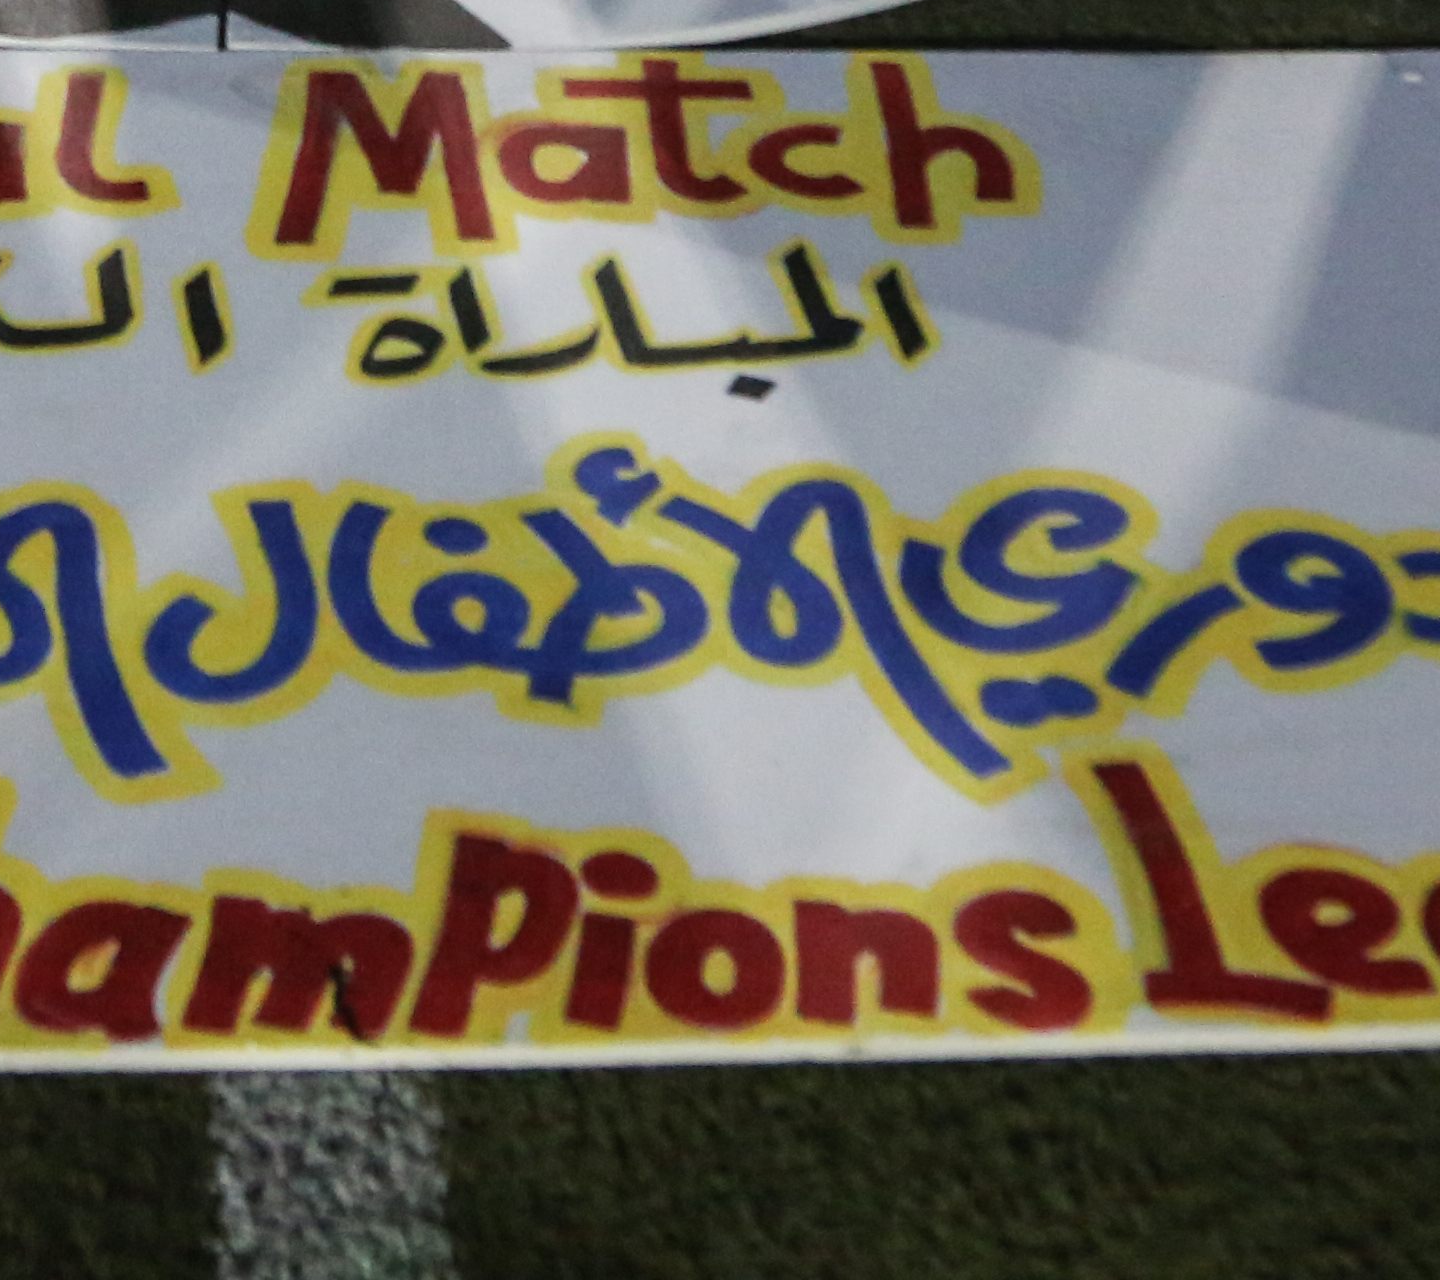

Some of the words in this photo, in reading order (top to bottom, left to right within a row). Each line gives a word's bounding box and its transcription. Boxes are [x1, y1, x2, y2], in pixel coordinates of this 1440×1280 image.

[274, 58, 1016, 243] Match
[328, 243, 928, 401] المباراة
[144, 447, 1010, 778] الأطفال
